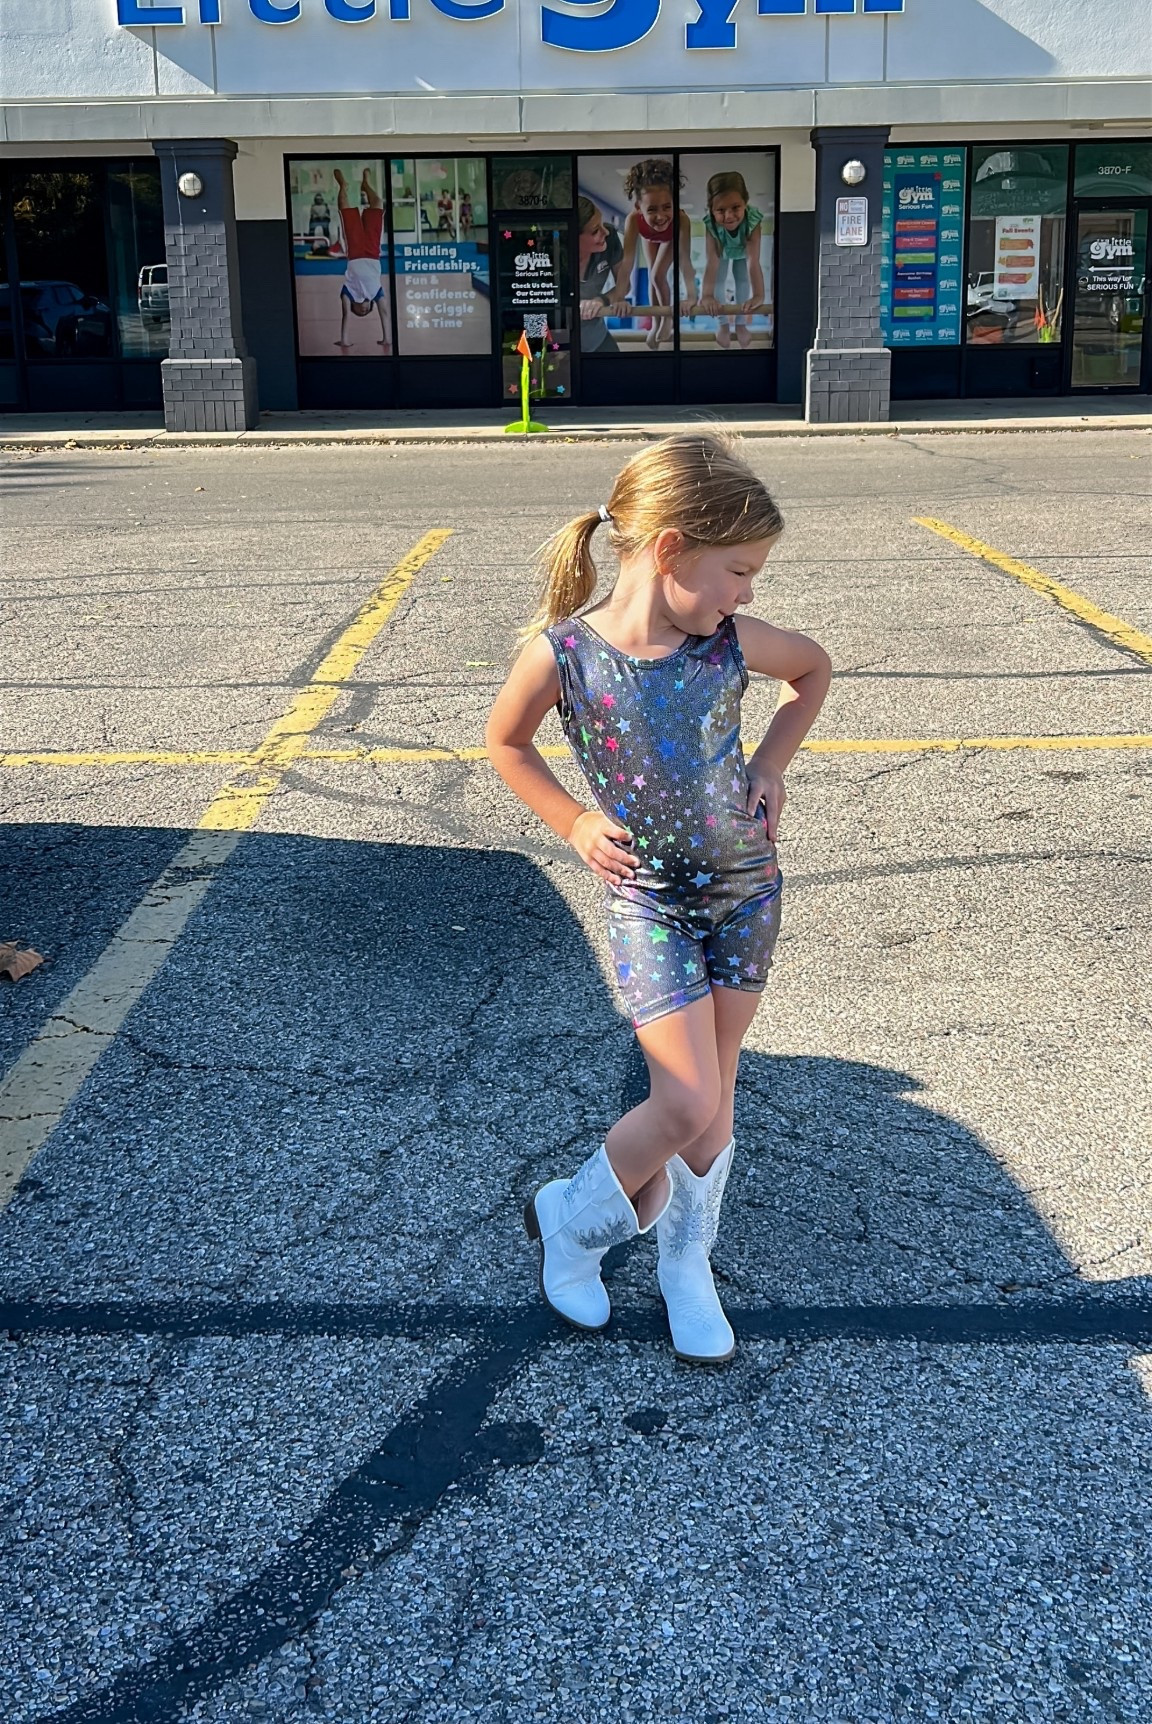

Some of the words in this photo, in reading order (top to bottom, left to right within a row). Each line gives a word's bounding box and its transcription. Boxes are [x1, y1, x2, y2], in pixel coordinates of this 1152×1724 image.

[1098, 166, 1132, 175] 3870-F
[899, 189, 933, 204] gym
[840, 202, 848, 212] NO
[841, 215, 862, 225] FIRE
[840, 227, 863, 236] LANE
[1107, 237, 1132, 246] Little
[404, 245, 457, 259] Building
[1090, 241, 1133, 260] gym
[404, 259, 480, 273] Friendships,
[514, 255, 551, 270] gym
[405, 275, 428, 285] Fun
[430, 275, 439, 285] &
[1087, 283, 1118, 291] SERIOUS
[406, 289, 476, 299] Confidence
[434, 302, 474, 316] Giggle
[431, 318, 463, 328] Time
